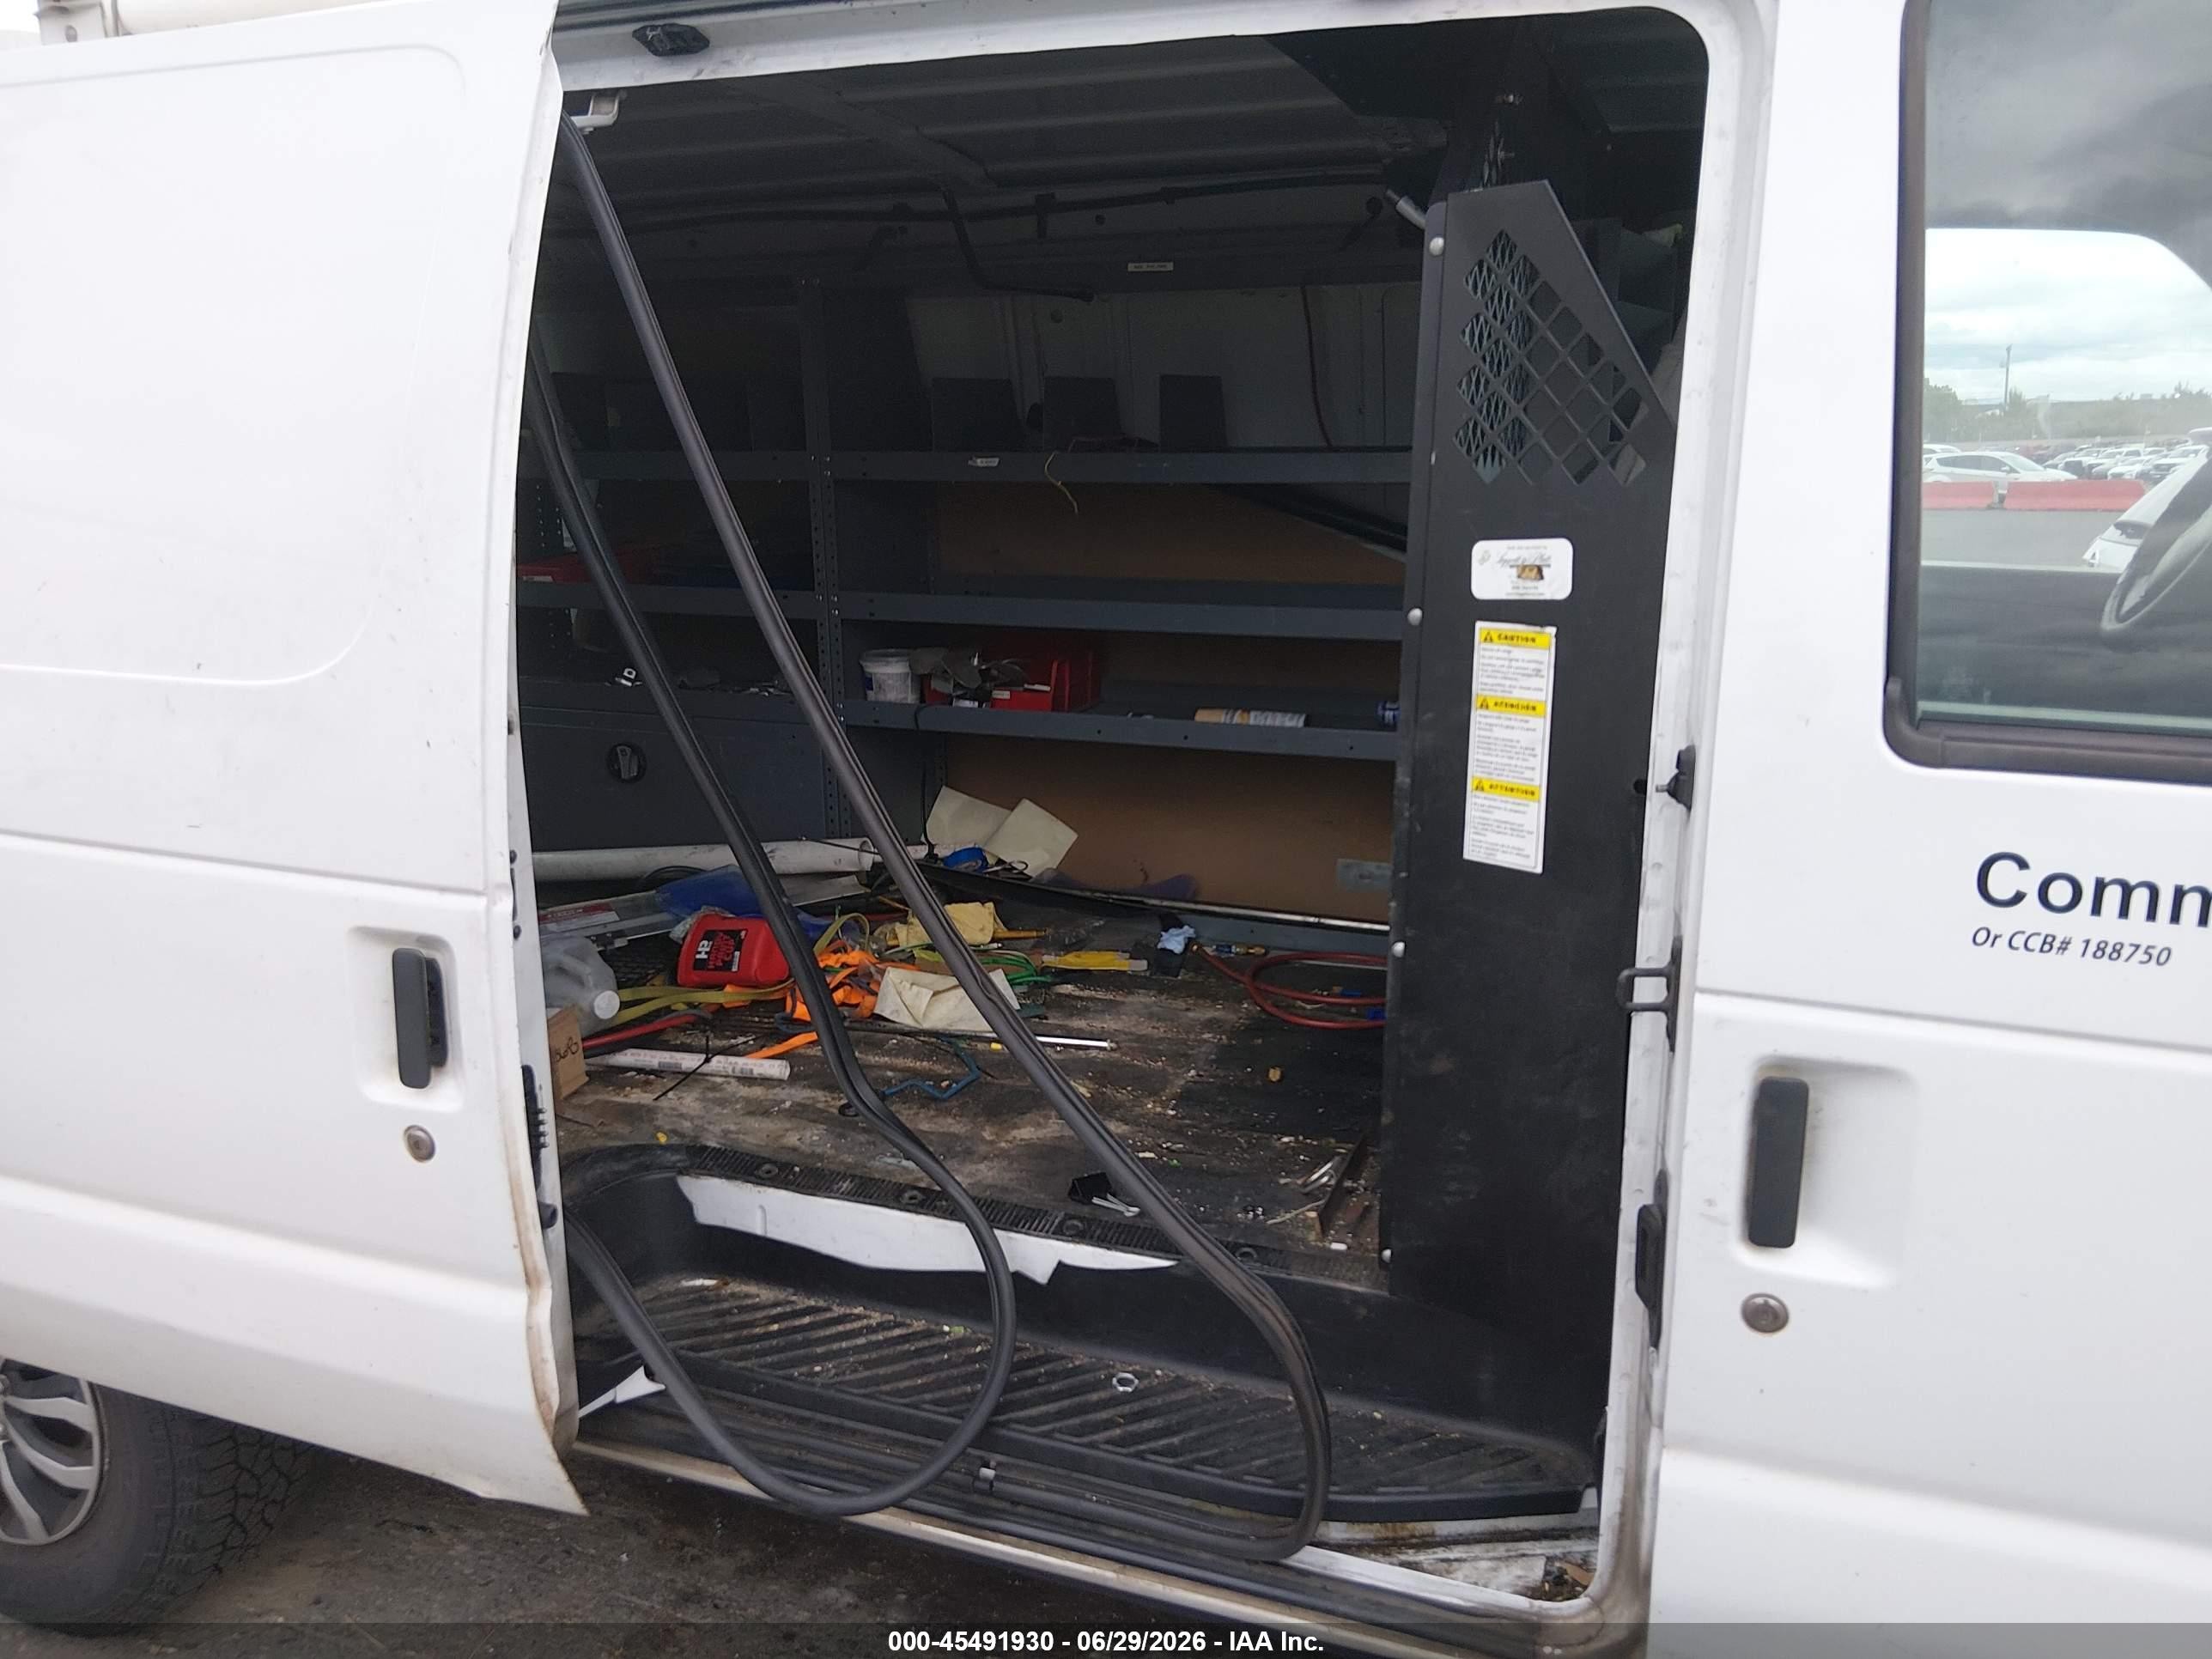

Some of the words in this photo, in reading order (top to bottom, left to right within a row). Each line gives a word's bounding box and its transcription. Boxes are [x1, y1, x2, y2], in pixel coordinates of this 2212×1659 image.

[1497, 632, 1536, 644] CAUTION
[1972, 926, 2003, 949] Or
[2008, 930, 2073, 956] CCB#
[2080, 938, 2172, 967] 188750
